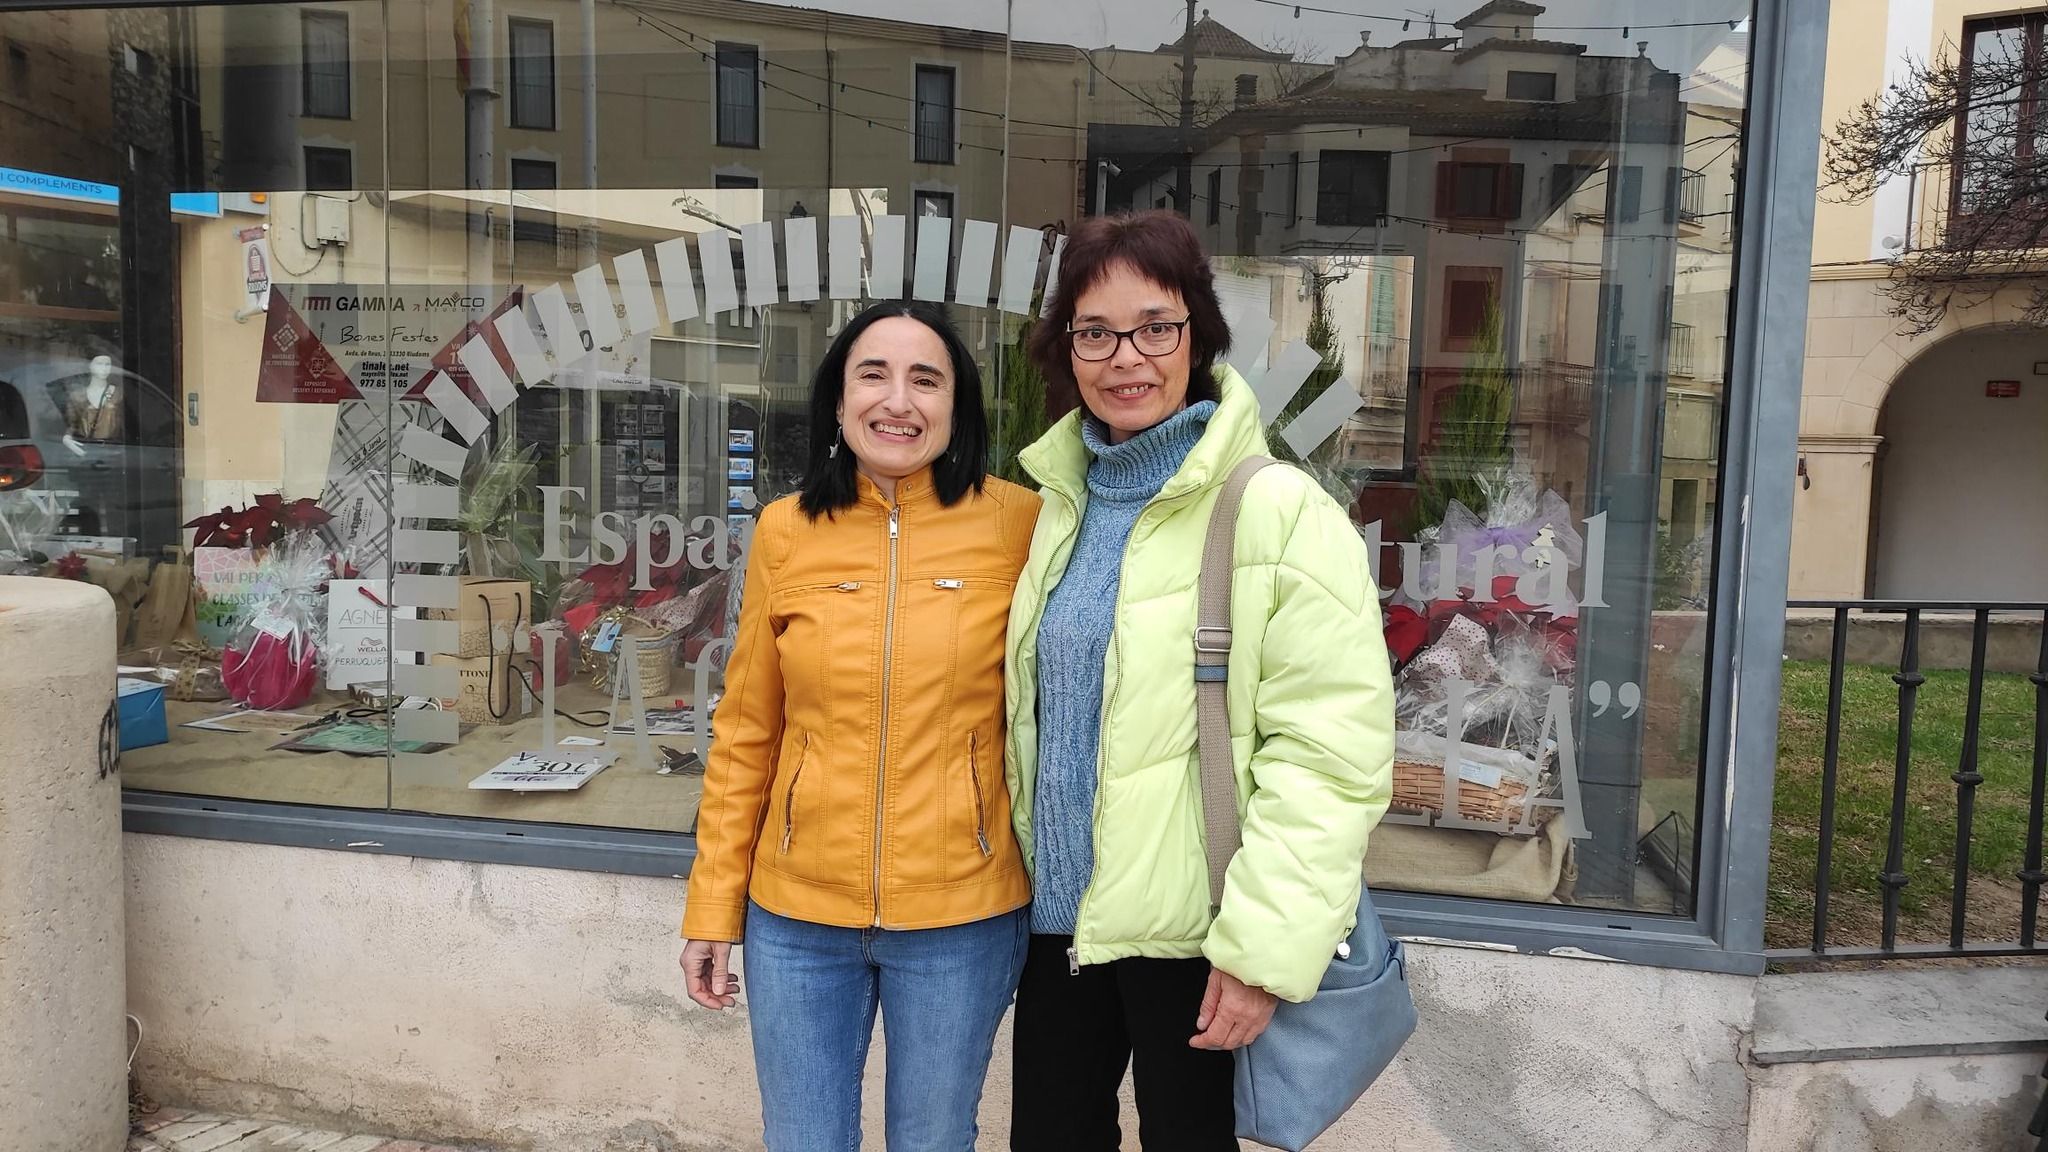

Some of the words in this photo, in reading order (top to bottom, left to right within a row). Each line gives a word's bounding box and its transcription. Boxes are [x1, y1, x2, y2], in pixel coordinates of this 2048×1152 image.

[7, 173, 102, 194] COMPLEMENTS
[336, 296, 405, 311] GAMMA
[425, 296, 485, 308] MAYCO
[340, 325, 385, 345] Bones
[390, 326, 439, 343] Festes
[360, 379, 374, 388] 977
[393, 380, 408, 388] 105
[1364, 510, 1611, 609] tural
[212, 591, 260, 606] CLASSES
